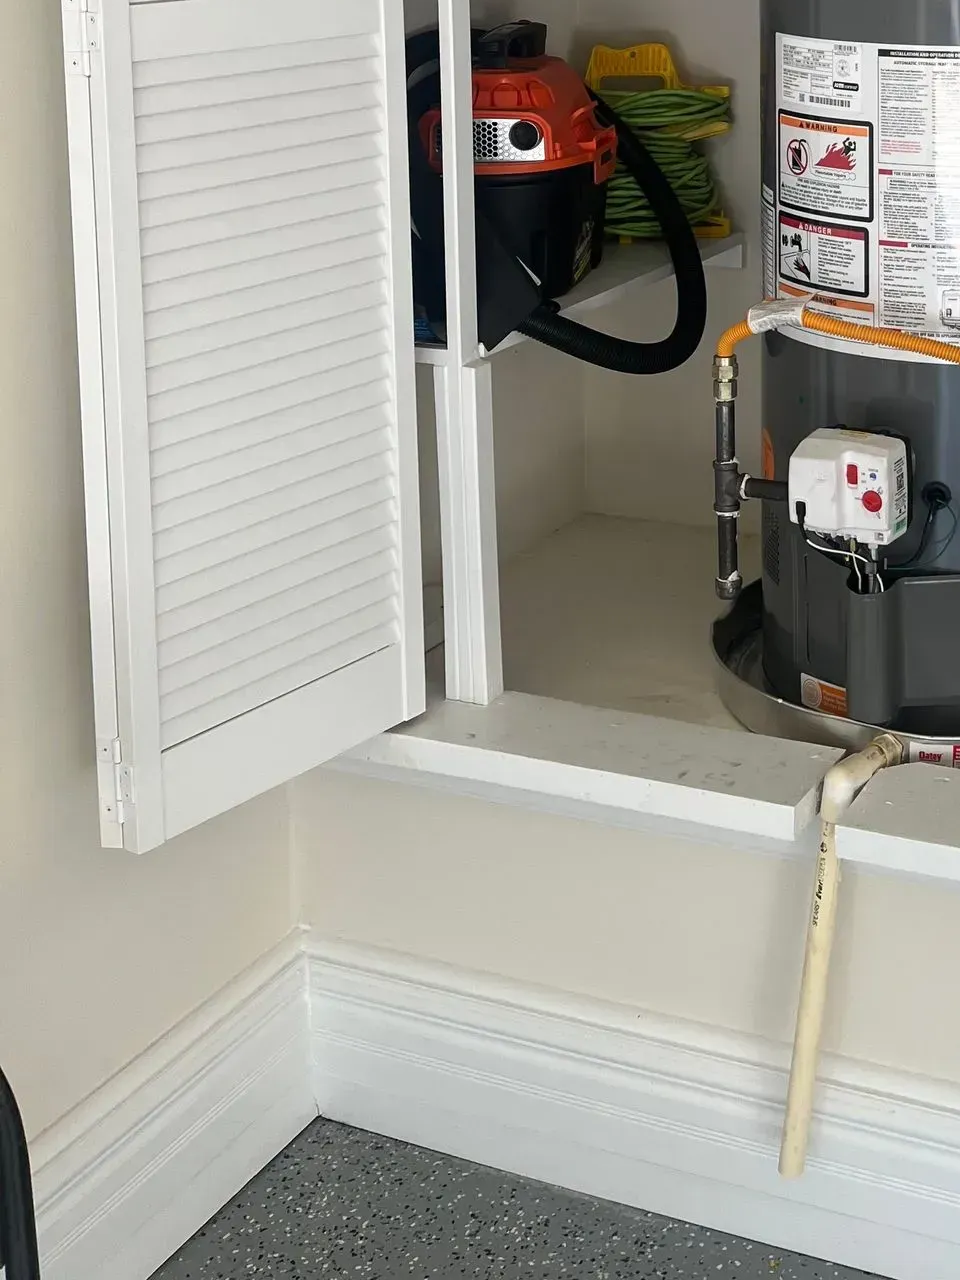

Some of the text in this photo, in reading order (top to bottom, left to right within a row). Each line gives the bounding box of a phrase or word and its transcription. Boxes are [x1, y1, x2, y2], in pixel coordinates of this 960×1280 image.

[806, 121, 838, 133] WARNING
[804, 223, 832, 235] DANGER
[919, 751, 942, 762] Oatey
